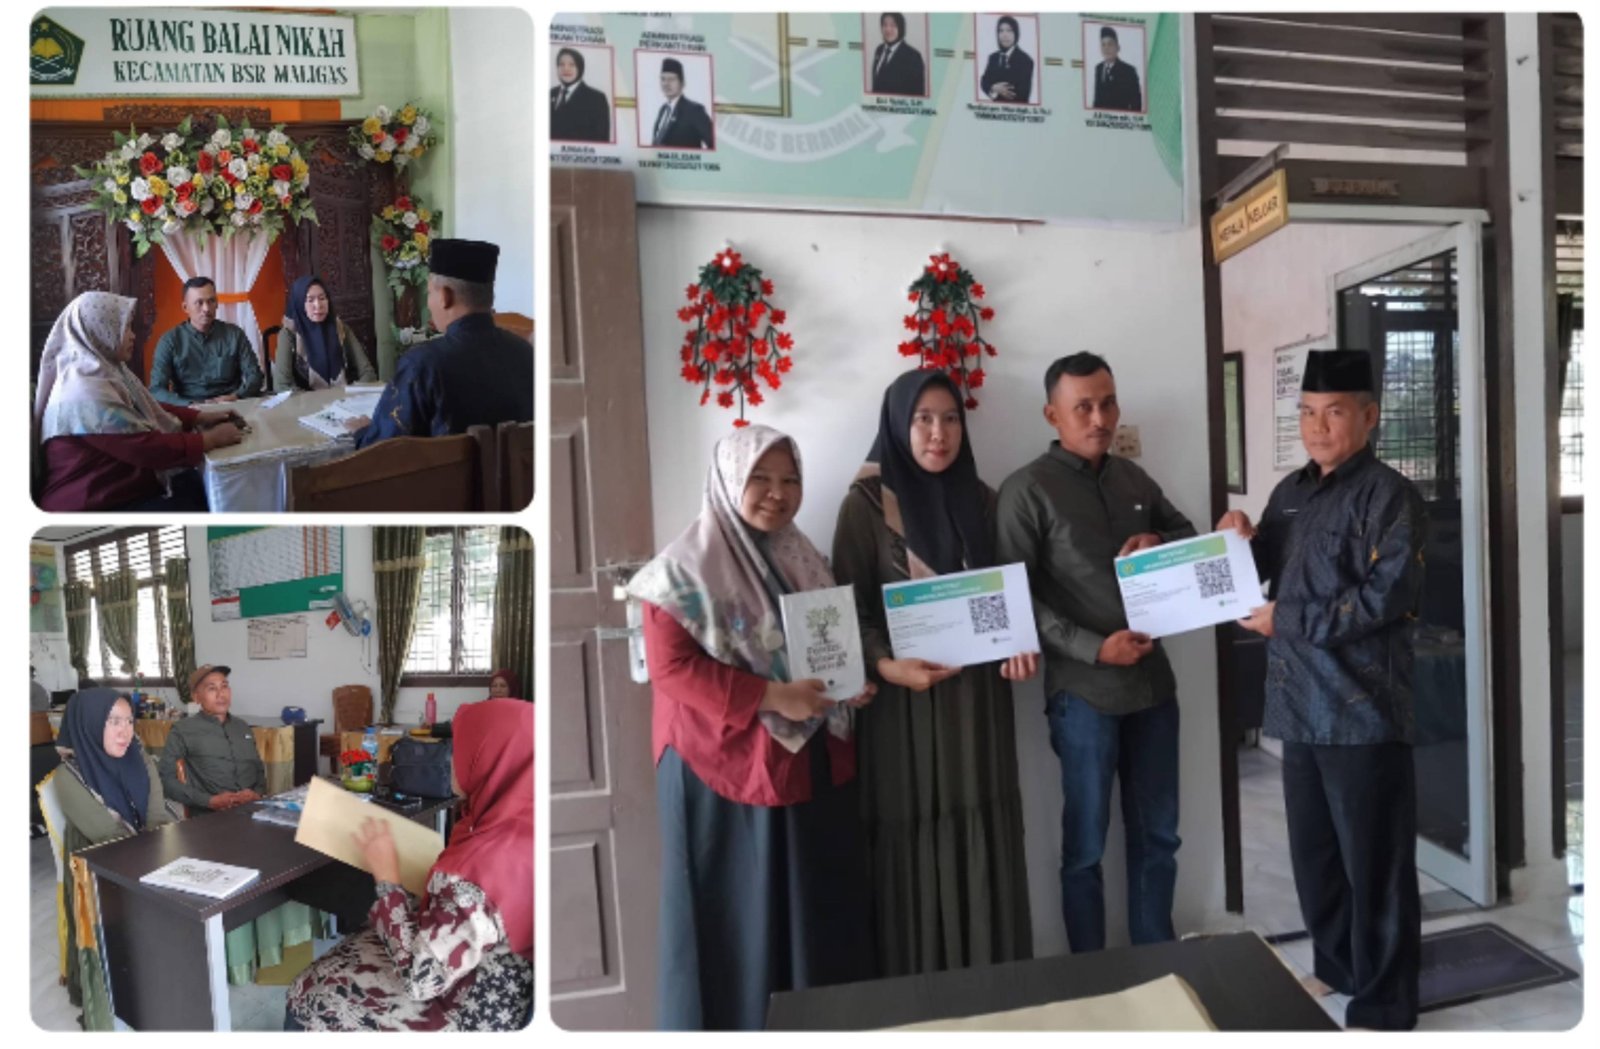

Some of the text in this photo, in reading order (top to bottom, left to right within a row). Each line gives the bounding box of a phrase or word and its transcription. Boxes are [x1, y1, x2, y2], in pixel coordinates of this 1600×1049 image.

[110, 18, 346, 58] RUANG BALAI NIKAH
[113, 60, 349, 85] KECAMATAN BSR MALIGAS
[780, 110, 873, 153] BERAMAL
